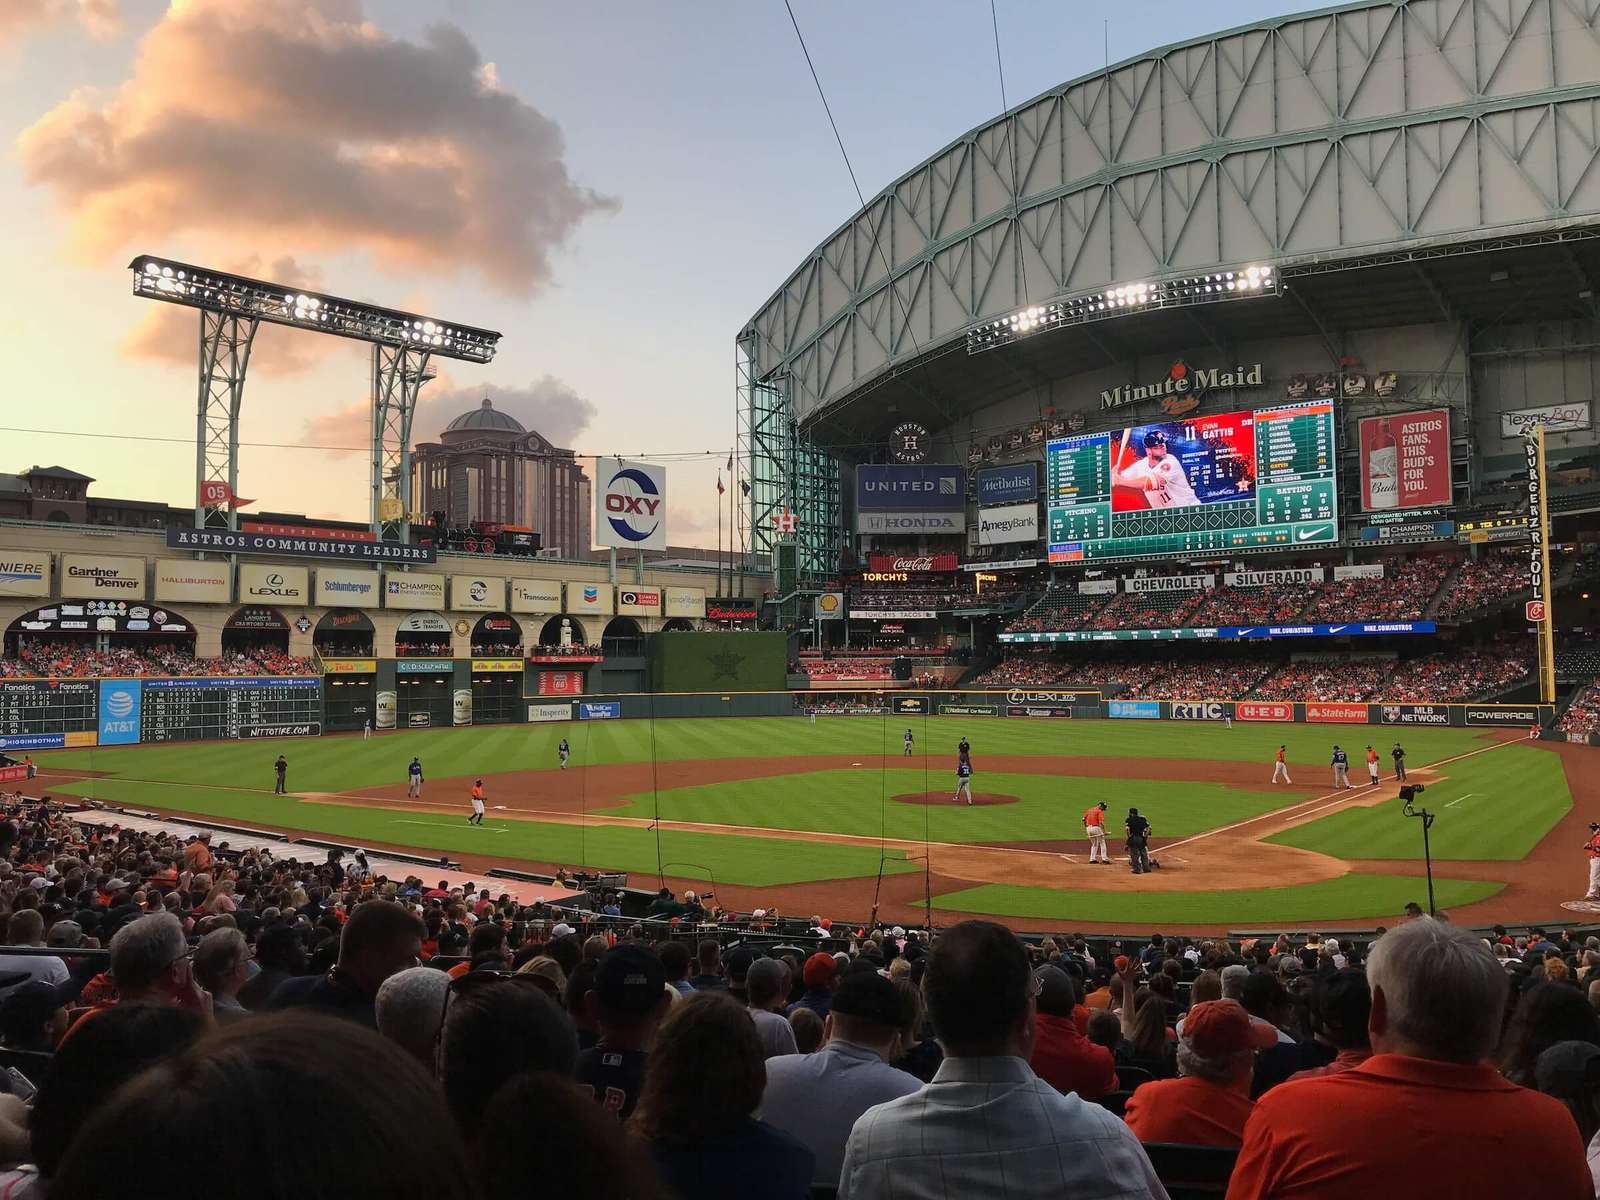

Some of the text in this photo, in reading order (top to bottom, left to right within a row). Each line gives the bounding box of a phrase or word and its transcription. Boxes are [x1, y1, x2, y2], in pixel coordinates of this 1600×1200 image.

[1100, 378, 1188, 410] Minute
[1194, 363, 1263, 389] Maid
[1552, 407, 1584, 422] Bay
[894, 423, 926, 436] HOUSTON
[1185, 425, 1197, 441] 11
[1402, 420, 1442, 434] ASTROS
[1202, 427, 1234, 440] GATTIS
[1402, 433, 1432, 446] FANS,
[903, 436, 918, 450] H
[896, 451, 925, 462] ASTROS
[1402, 445, 1426, 457] THIS
[1403, 455, 1435, 469] BUD'S
[1403, 468, 1424, 480] FOR
[865, 481, 935, 492] UNITED
[982, 475, 1031, 492] Methodist
[1404, 480, 1428, 491] YOU.
[1526, 444, 1540, 529] BURGERZ
[207, 486, 226, 500] 05
[1276, 485, 1312, 495] BATTING
[1160, 492, 1171, 504] 11
[605, 493, 661, 516] OXY
[1064, 507, 1097, 517] PITCHING
[885, 518, 955, 528] HONDA
[1390, 524, 1434, 533] CHAMPION
[1488, 531, 1521, 541] generation
[178, 532, 429, 560] ASTROS COMMUNITY LEADERS
[68, 566, 119, 577] Gardner
[863, 573, 908, 582] TORCHYS
[1530, 549, 1542, 598] FOUL
[94, 577, 139, 589] Denver
[161, 576, 225, 585] HALLIBURTON
[1133, 576, 1206, 591] CHEVROLET
[1235, 570, 1313, 586] SILVERADO
[249, 587, 299, 597] LEXUS
[324, 580, 371, 594] Schlumberger
[400, 582, 442, 591] CHAMPION
[469, 587, 488, 595] OXY
[4, 683, 36, 691] Fanatics
[539, 708, 570, 717] Insperity
[1172, 703, 1224, 719] RTIC
[1413, 706, 1434, 714] MLB
[1468, 711, 1534, 720] POWERADE
[1401, 714, 1447, 723] NETWORK
[104, 721, 136, 733] AT&T
[250, 725, 310, 737] NITTOTIRE.COM
[7, 737, 62, 745] HIGGINBOTHAM
